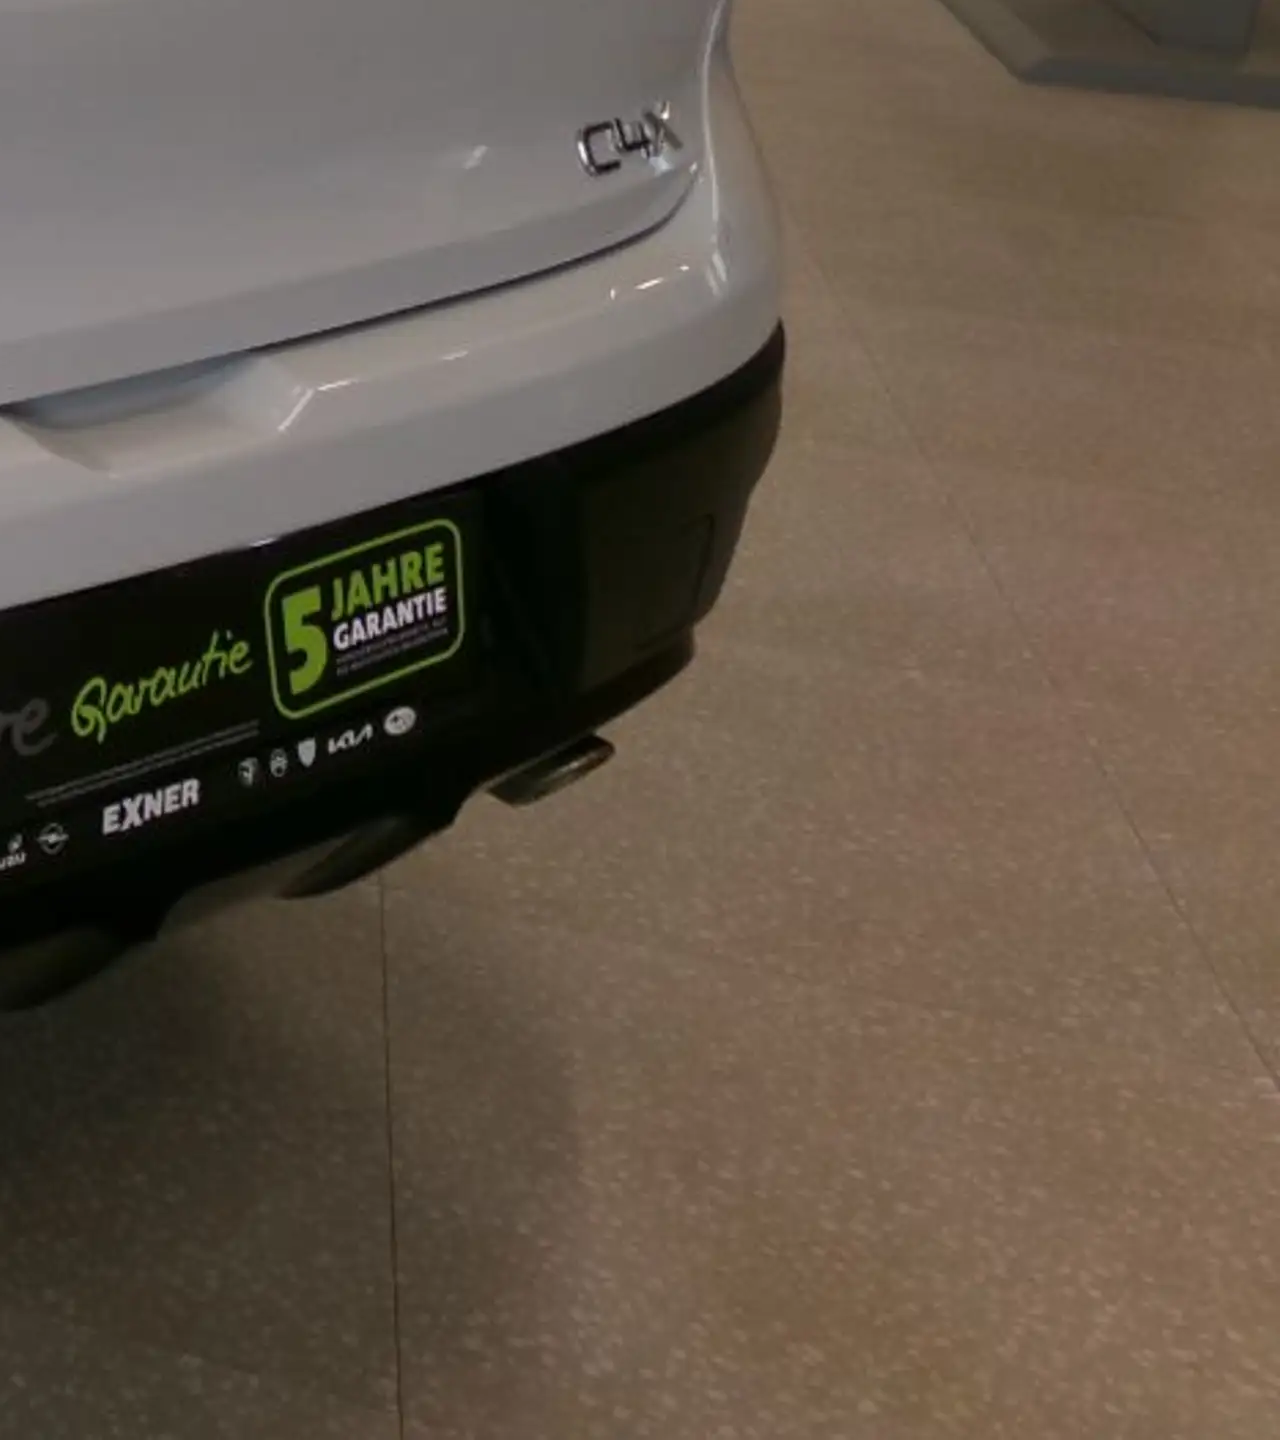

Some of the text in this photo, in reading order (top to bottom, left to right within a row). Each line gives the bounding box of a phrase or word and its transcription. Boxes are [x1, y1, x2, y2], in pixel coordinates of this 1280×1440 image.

[330, 541, 445, 622] JAHRE
[332, 585, 448, 652] GARANTIE
[281, 585, 328, 696] 5
[101, 777, 201, 836] EXNER
